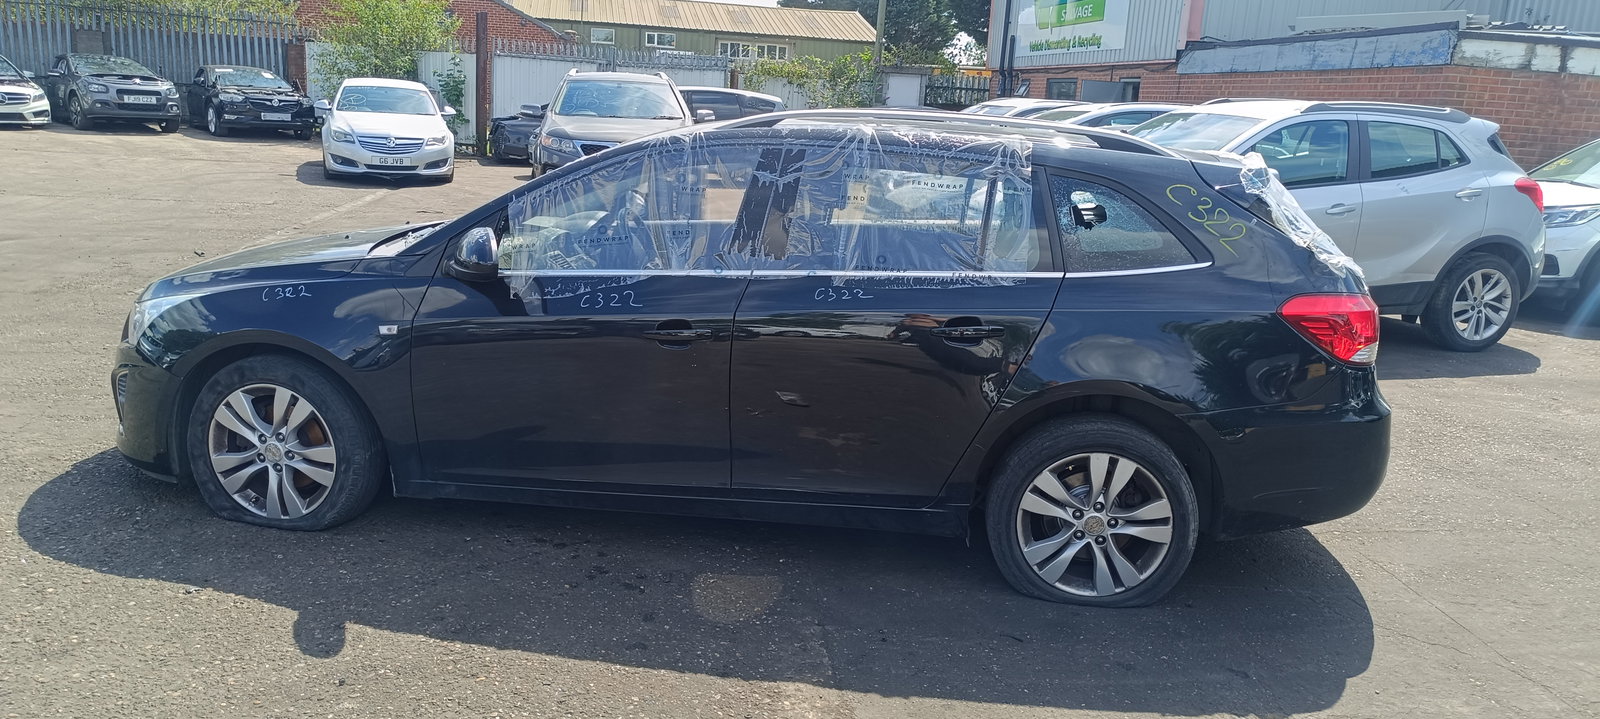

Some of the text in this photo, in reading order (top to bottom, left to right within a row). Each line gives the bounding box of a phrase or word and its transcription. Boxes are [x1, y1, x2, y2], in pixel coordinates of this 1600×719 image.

[1060, 4, 1093, 21] SAGE
[911, 179, 964, 190] FENDWRAP
[1165, 183, 1247, 258] C322
[511, 242, 536, 251] WRAP
[578, 235, 629, 245] FENDWRAP
[580, 290, 644, 308] C322
[814, 287, 875, 302] C322
